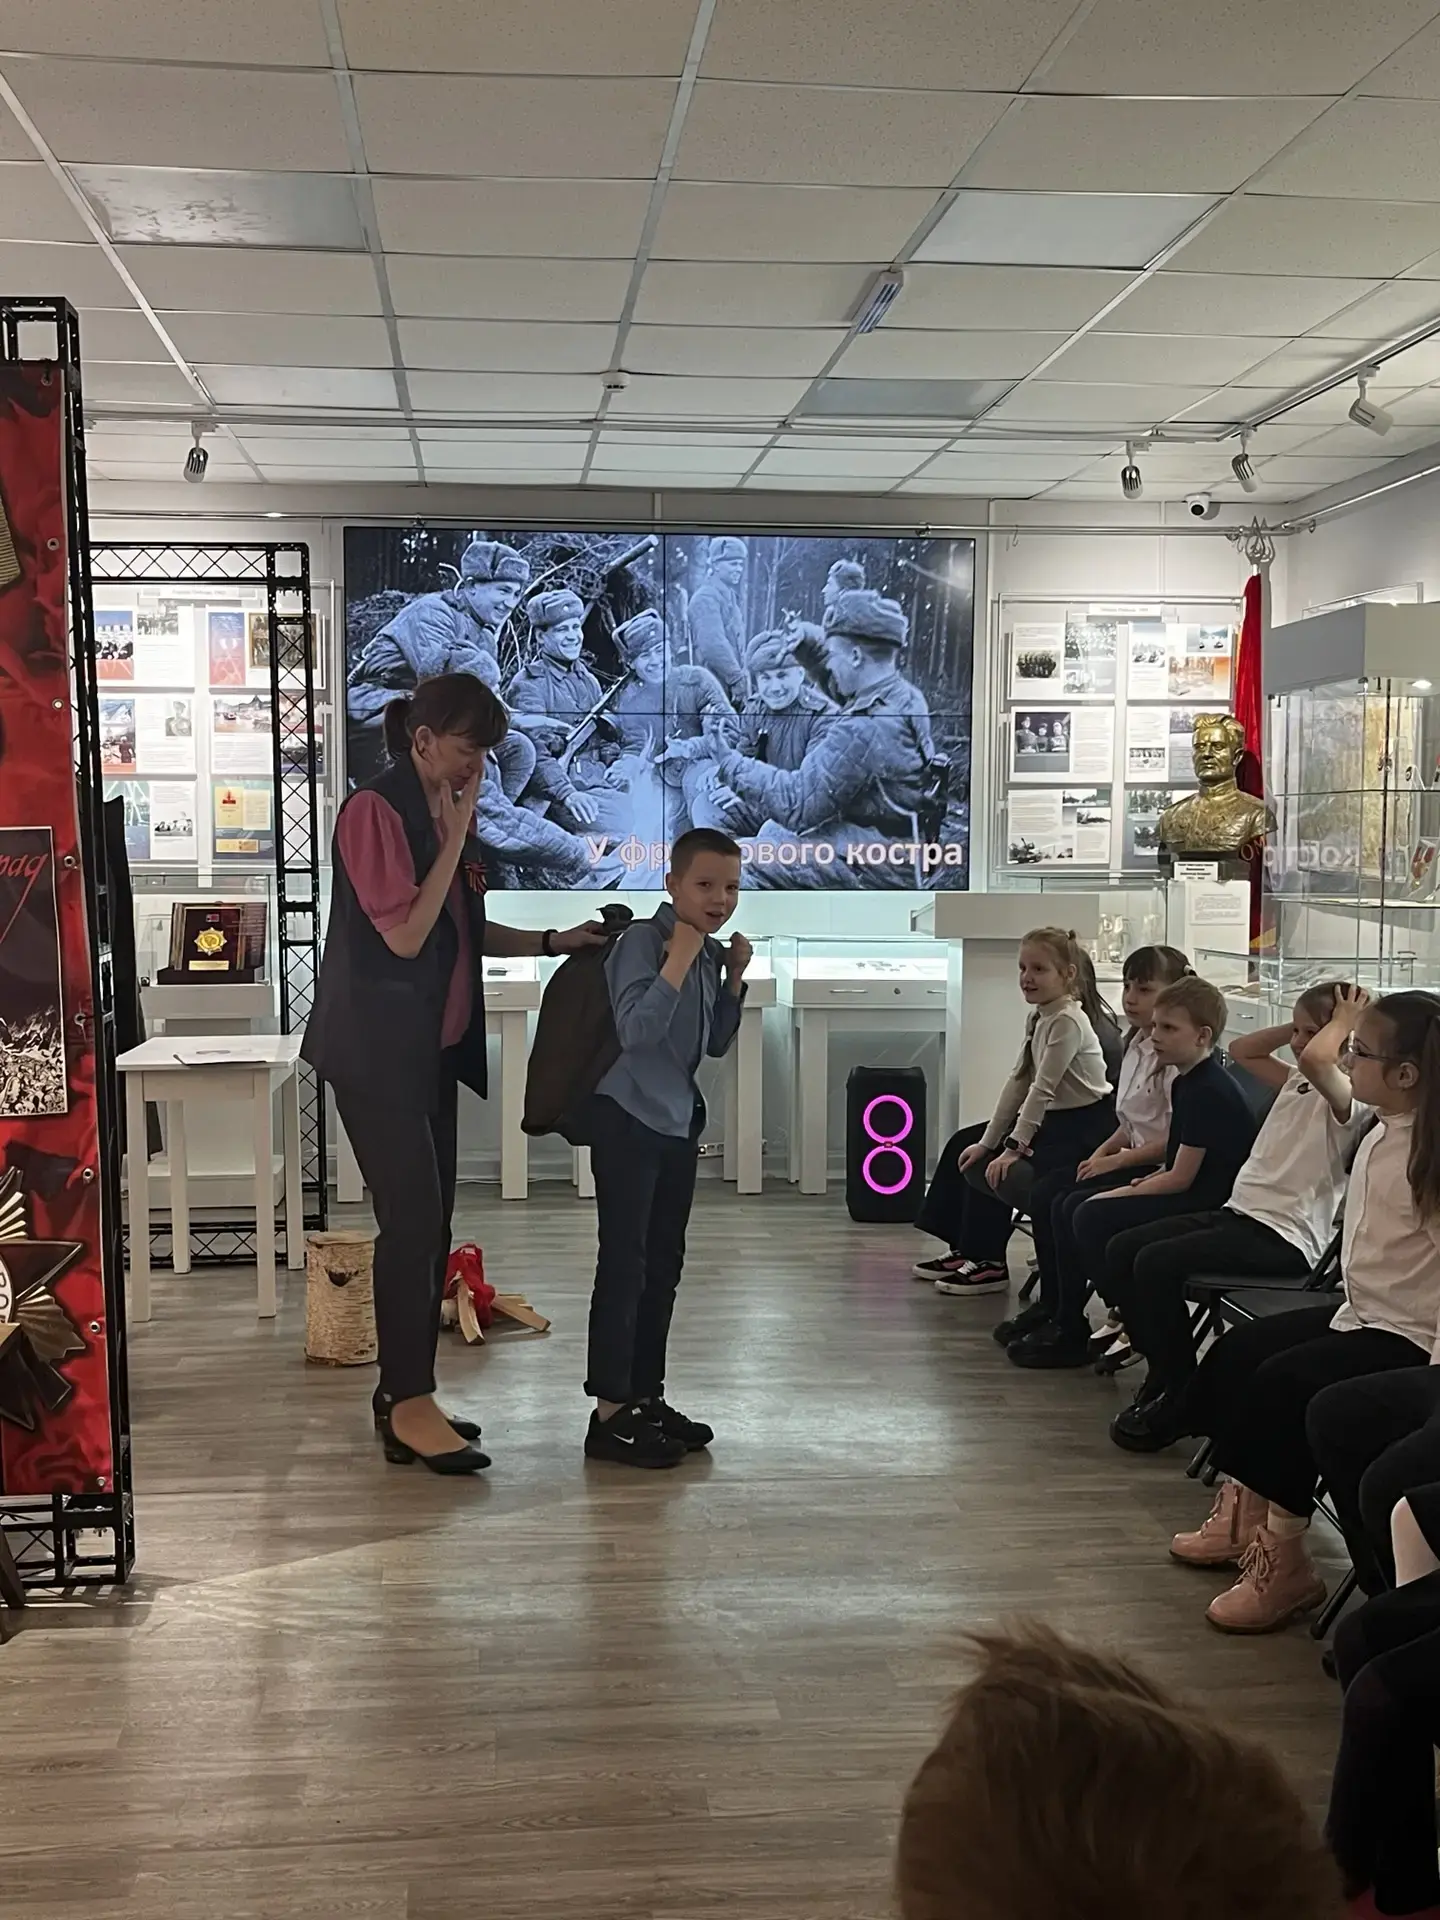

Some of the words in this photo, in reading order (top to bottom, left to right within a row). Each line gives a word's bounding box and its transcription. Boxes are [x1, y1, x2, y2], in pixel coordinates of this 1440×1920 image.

[586, 835, 608, 864] У
[620, 834, 835, 871] фрового
[846, 842, 963, 872] костра
